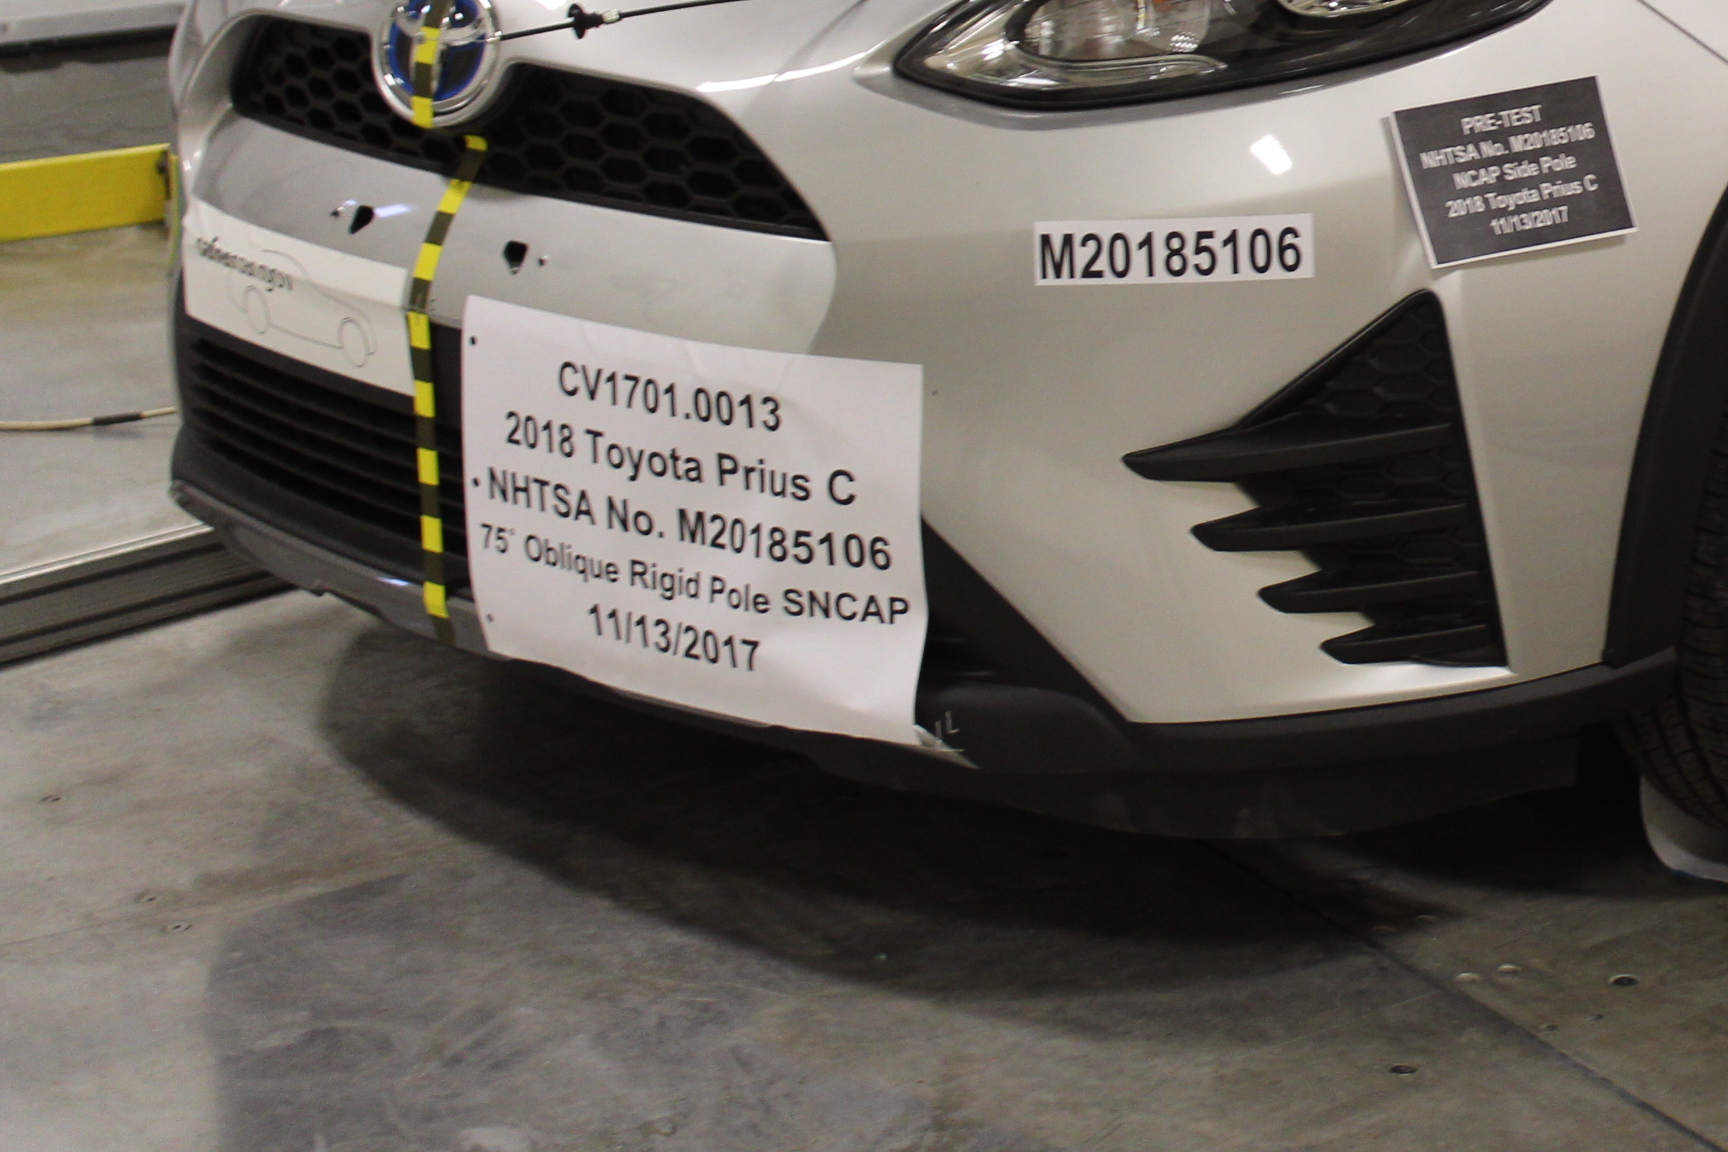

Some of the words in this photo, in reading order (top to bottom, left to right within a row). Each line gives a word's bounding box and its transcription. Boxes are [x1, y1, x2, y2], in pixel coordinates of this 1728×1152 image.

[1419, 143, 1480, 169] NHTSA
[1479, 140, 1509, 159] No.
[1508, 122, 1596, 153] M20185106
[1460, 104, 1542, 135] PRE-TEST
[1445, 196, 1486, 218] 2018
[1483, 186, 1541, 211] Toyota
[1539, 179, 1584, 199] Prius
[1583, 173, 1599, 192] C
[1452, 166, 1501, 190] NCAP
[1501, 160, 1540, 181] Side
[1539, 152, 1578, 174] Pole
[1490, 205, 1569, 235] 11/13/2017
[1039, 225, 1303, 280] M20185106
[557, 360, 782, 433] CV1701.0013
[504, 410, 576, 459] 2018
[585, 427, 705, 486] Toyota
[717, 451, 811, 503] Prius
[826, 468, 857, 507] C
[486, 466, 597, 526] NHTSA
[606, 498, 666, 540] No.
[676, 506, 892, 572] M20185106
[523, 533, 620, 588] Oblique
[629, 557, 701, 608] Rigid
[708, 575, 771, 615] Pole
[781, 588, 911, 627] SNCAP
[586, 602, 761, 672] 11/13/2017
